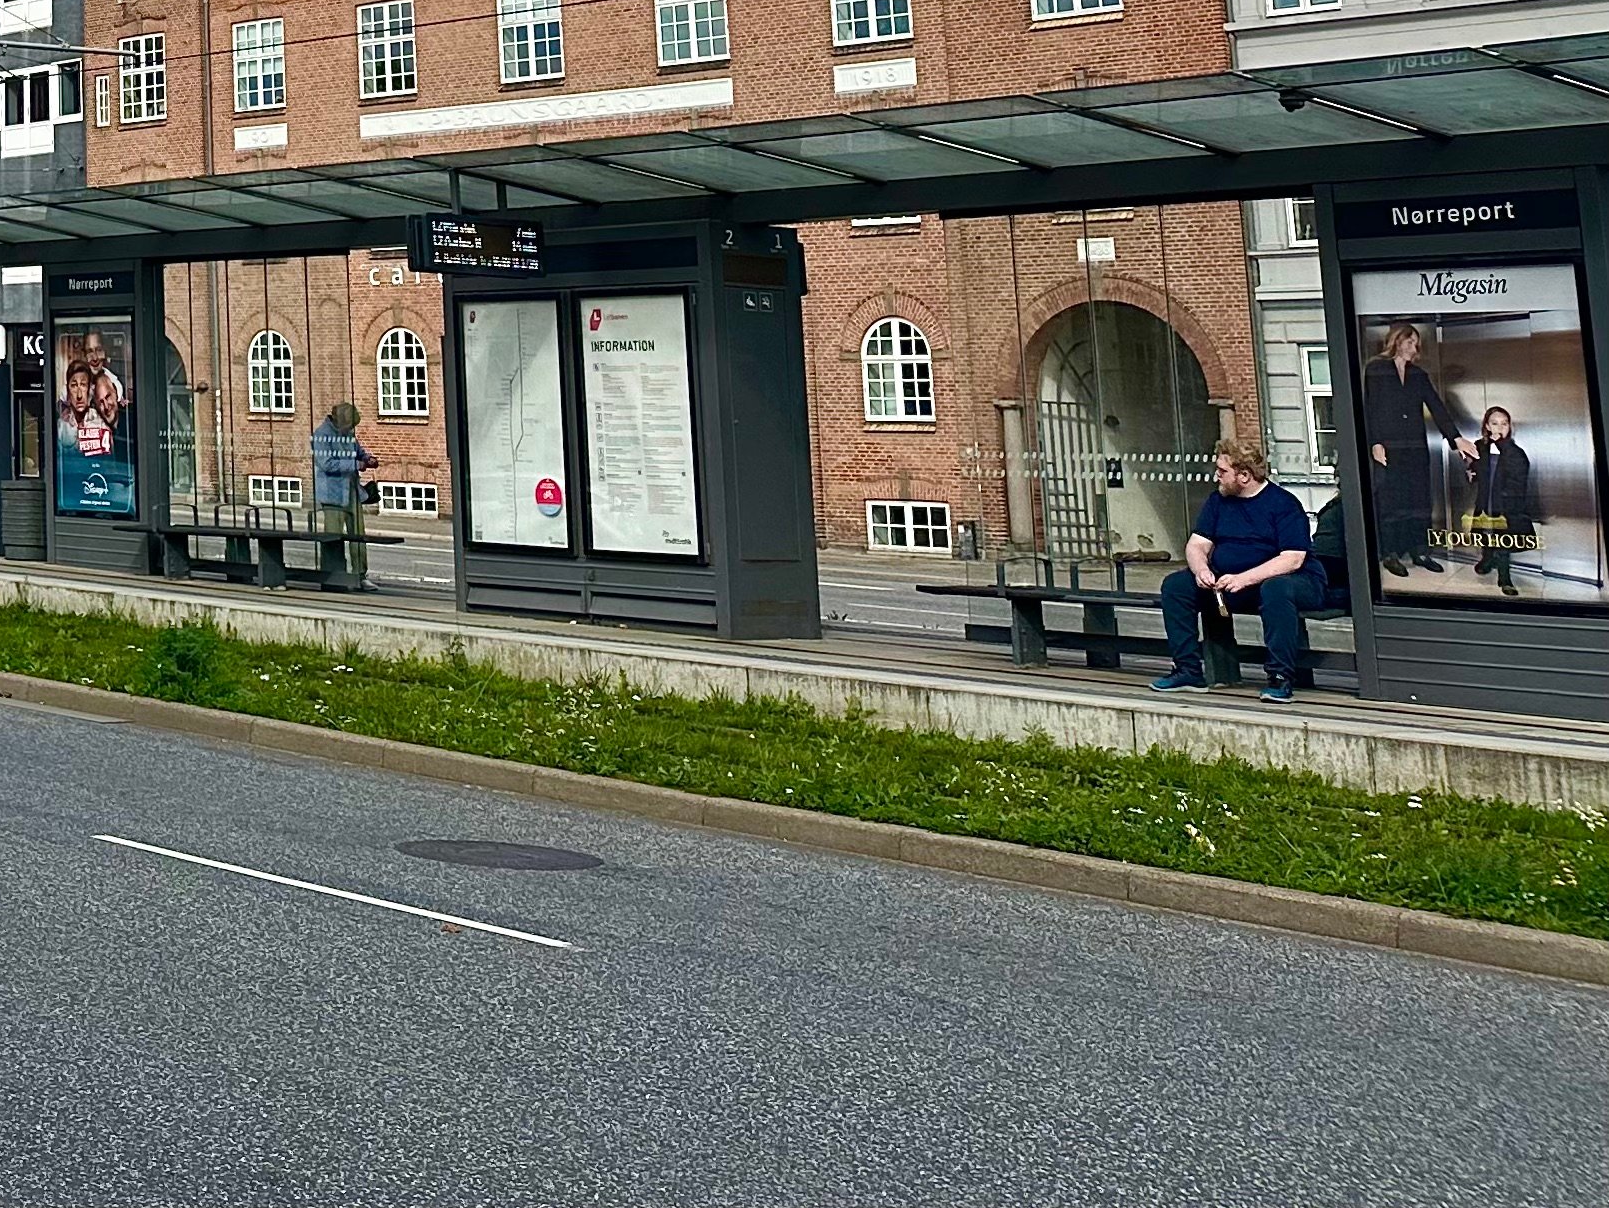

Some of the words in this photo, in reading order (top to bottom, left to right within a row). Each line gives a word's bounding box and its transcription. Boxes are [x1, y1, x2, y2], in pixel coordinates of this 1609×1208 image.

[1392, 202, 1515, 226] Nørreport
[725, 229, 734, 245] 2
[775, 234, 783, 249] 1
[68, 277, 113, 291] Nørreport
[1417, 271, 1508, 304] Magasin
[591, 340, 655, 352] INFORMATION
[101, 430, 111, 453] 4
[1427, 529, 1485, 549] [Y]OUR
[1487, 533, 1546, 550] HOUSE
